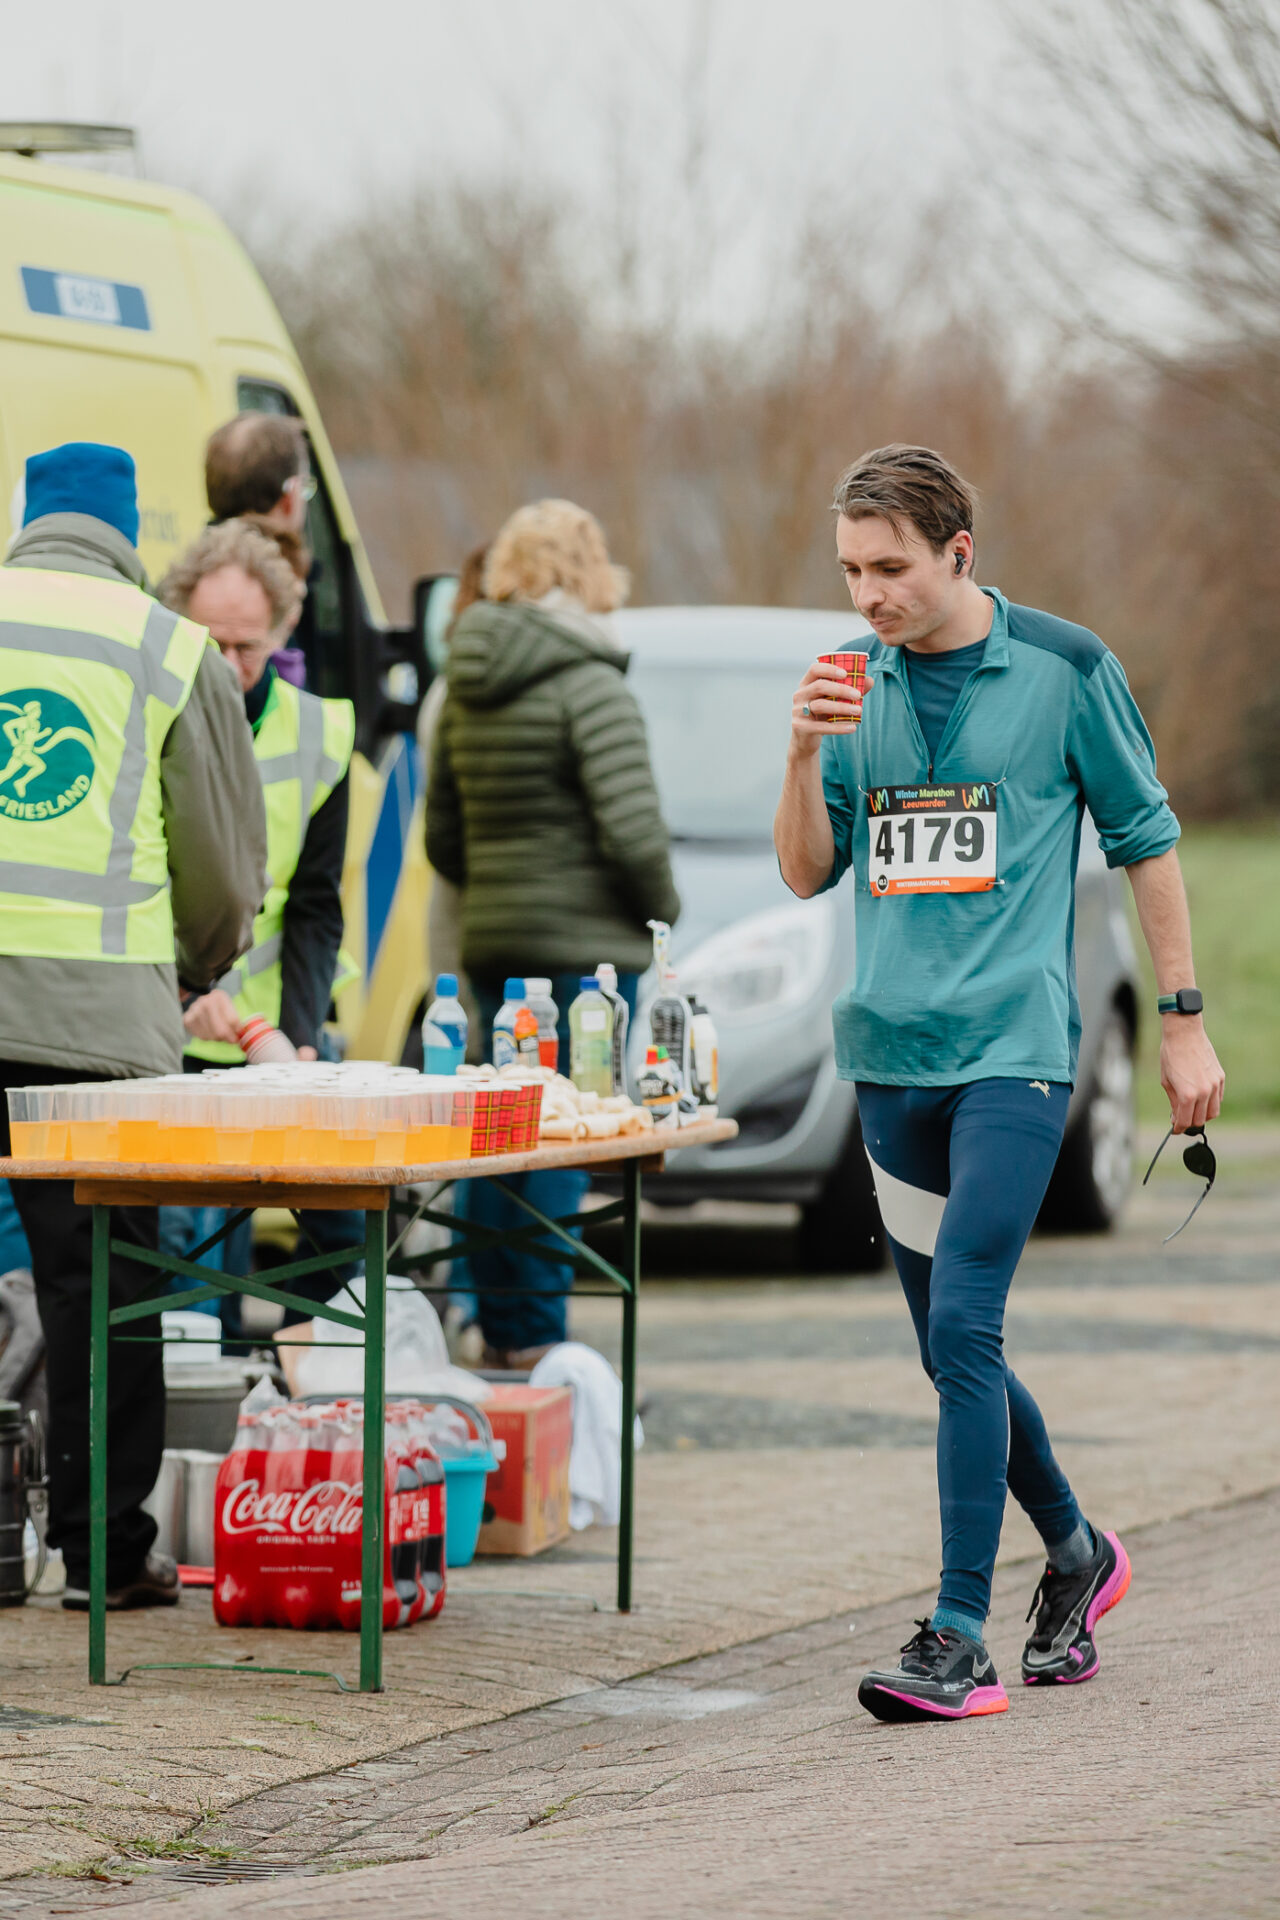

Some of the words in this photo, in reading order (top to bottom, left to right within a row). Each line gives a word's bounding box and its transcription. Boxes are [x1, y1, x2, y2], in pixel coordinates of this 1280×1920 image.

[895, 789, 919, 800] Winter
[919, 788, 955, 798] Marathon
[902, 799, 947, 809] Leeuwarden
[875, 816, 985, 865] 4179
[256, 1535, 304, 1545] ORIGINAL
[307, 1535, 337, 1545] TASTE
